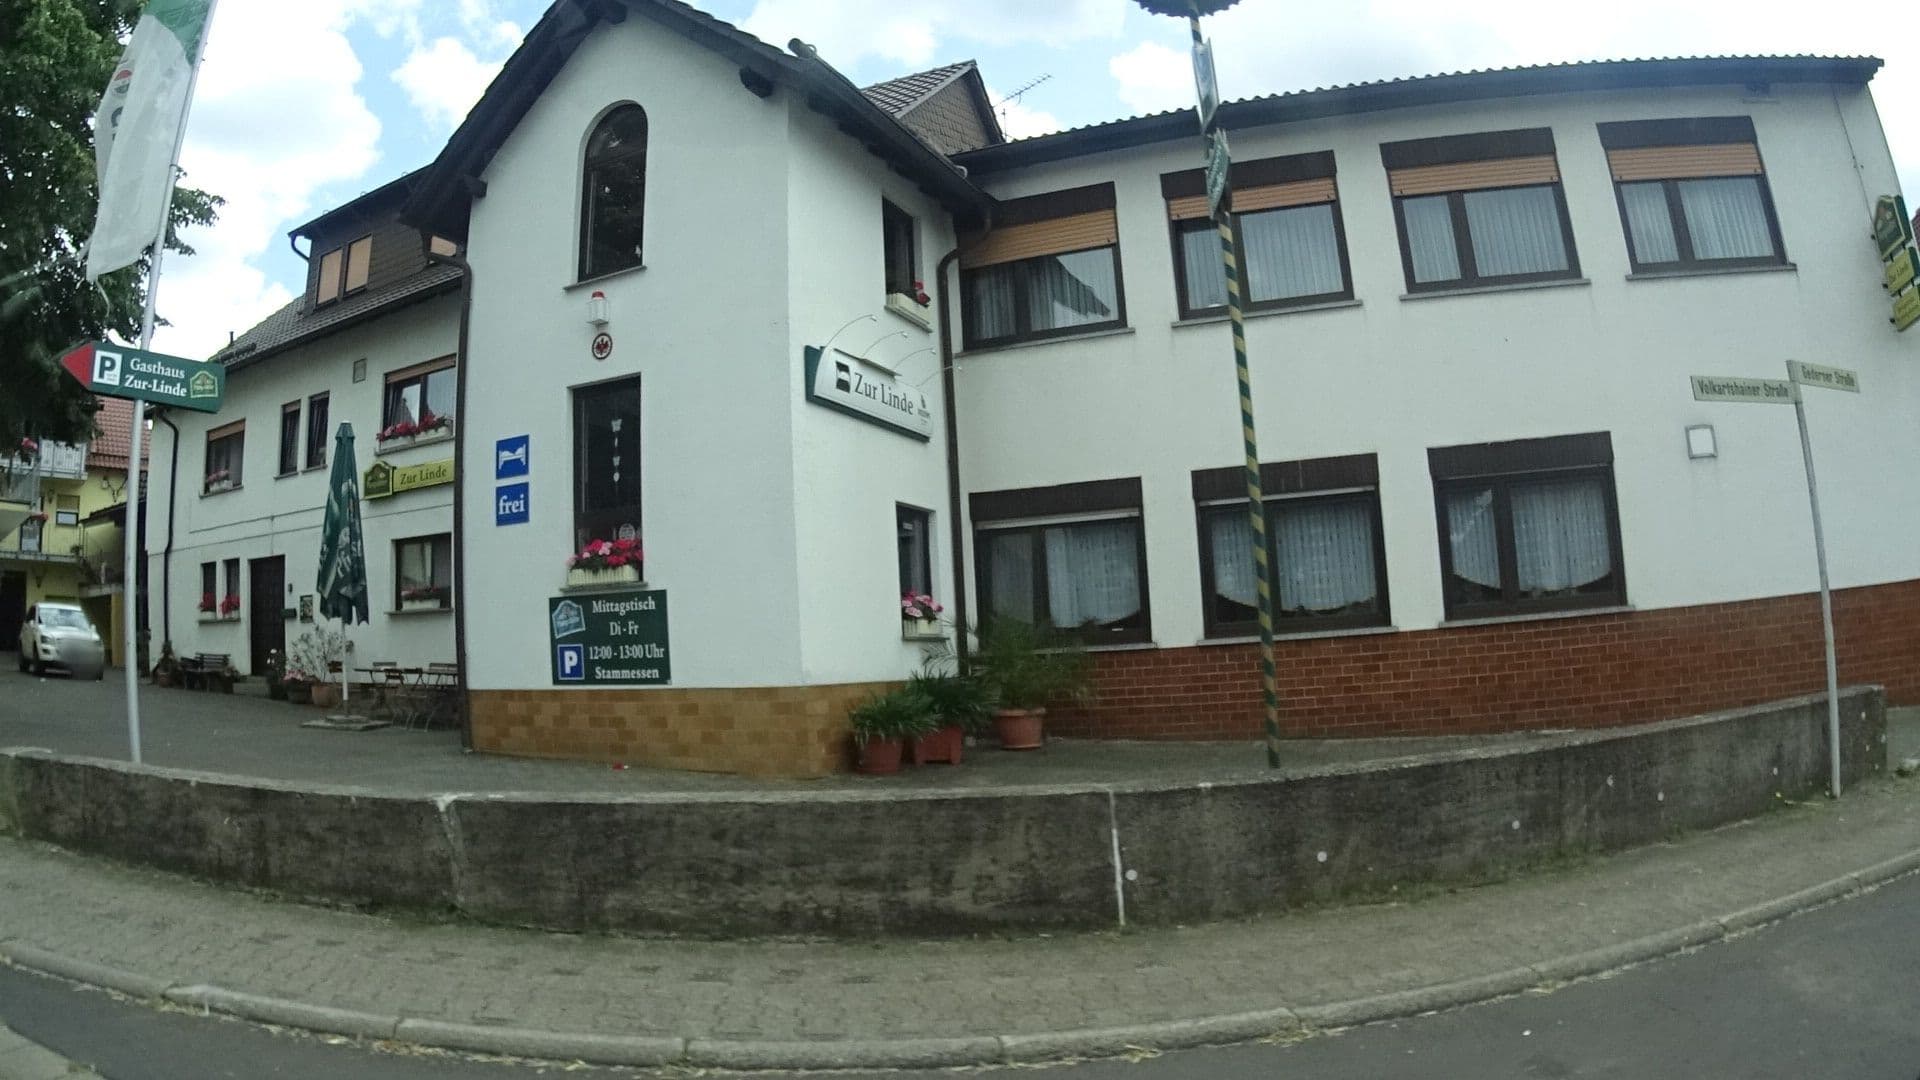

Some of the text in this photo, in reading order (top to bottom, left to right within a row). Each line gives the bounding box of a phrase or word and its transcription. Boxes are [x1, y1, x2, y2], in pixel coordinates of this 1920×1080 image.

[98, 356, 116, 379] P
[130, 358, 185, 379] Gasthaus
[124, 374, 187, 397] Zur-Linde
[854, 372, 914, 415] Zur Linde
[400, 473, 417, 485] Zur
[420, 465, 447, 481] Linde
[498, 493, 526, 515] frei
[592, 596, 656, 616] Mittagstisch
[564, 650, 578, 674] P
[589, 646, 612, 660] 12:00
[619, 644, 644, 659] 13:00
[644, 643, 665, 658] Uhr
[595, 666, 660, 679] Stammessen
